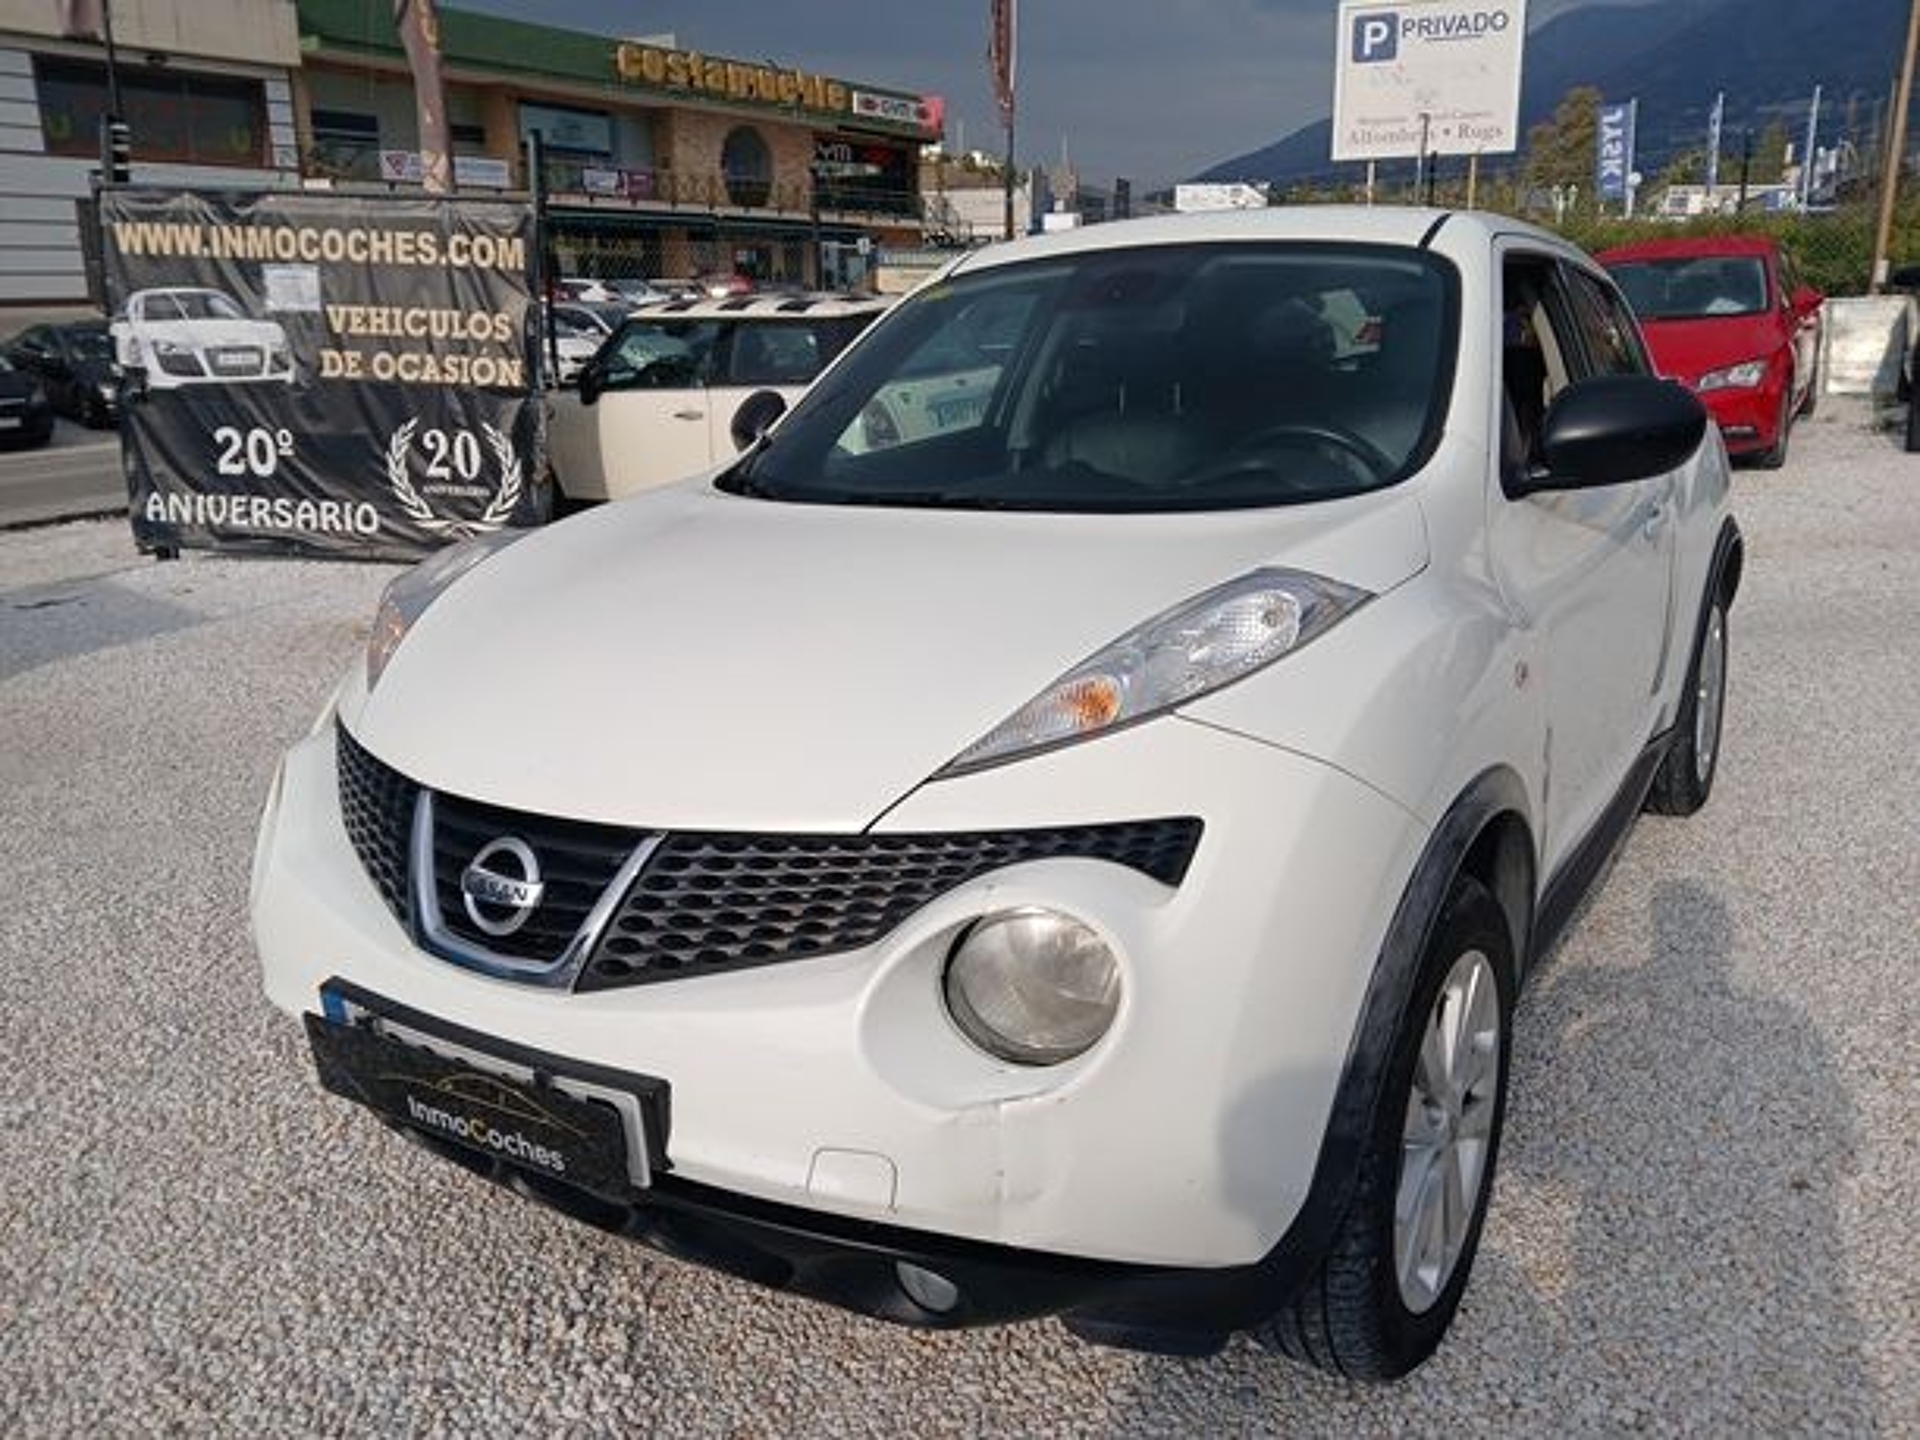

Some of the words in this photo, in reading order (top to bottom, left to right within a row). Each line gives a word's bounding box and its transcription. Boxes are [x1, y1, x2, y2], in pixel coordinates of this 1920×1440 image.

[1364, 20, 1388, 56] P
[1401, 10, 1509, 39] PRIVADO
[113, 222, 526, 271] WWW.INMOCOCHES.COM
[325, 304, 512, 342] VEHICULOS
[320, 350, 361, 380] DE
[372, 346, 522, 388] OCASIÓN
[422, 428, 483, 482] 20
[146, 491, 379, 535] ANIVERSARIO
[407, 1094, 567, 1172] InmoCoches
